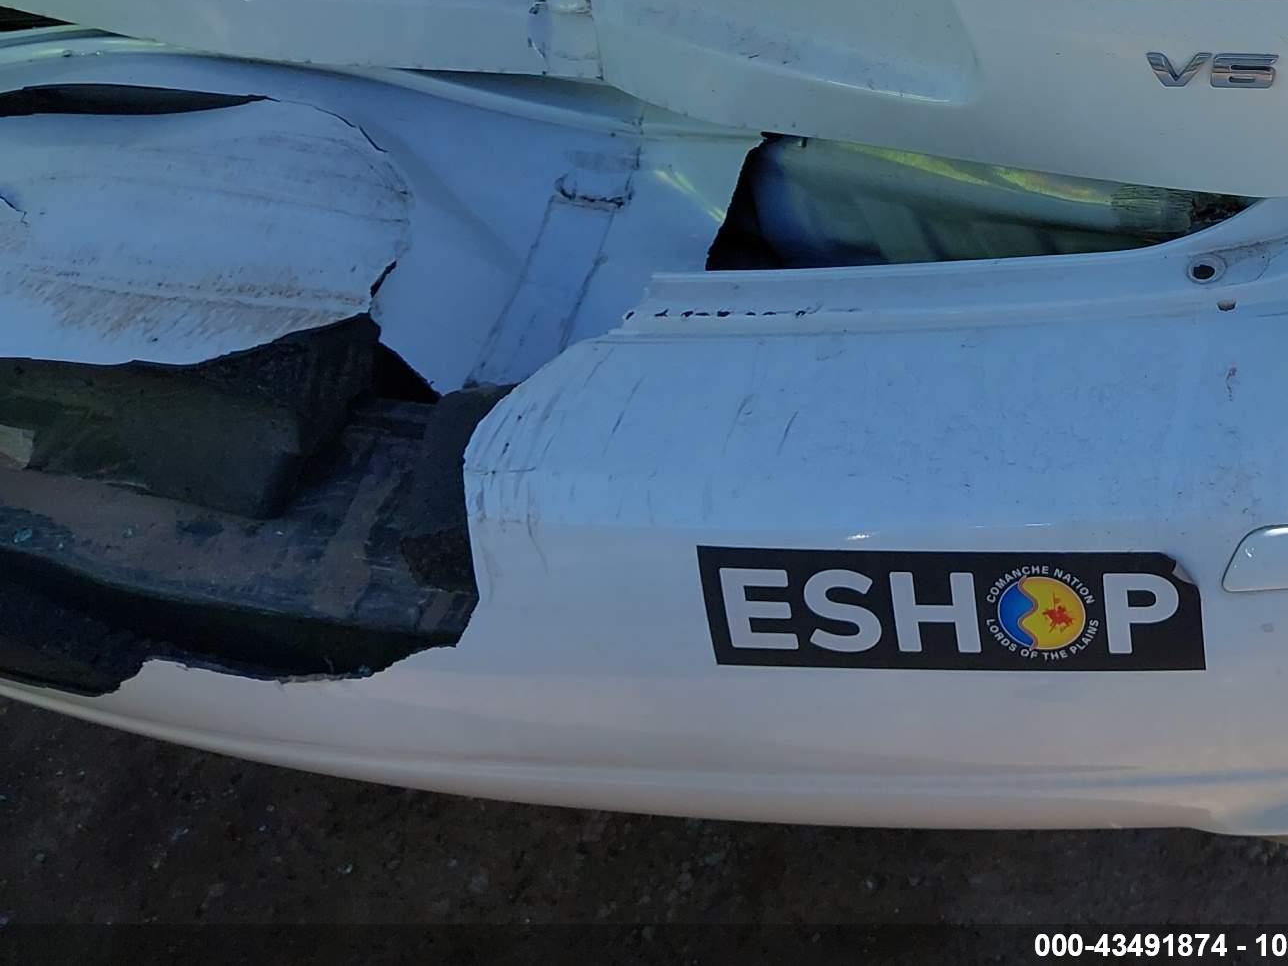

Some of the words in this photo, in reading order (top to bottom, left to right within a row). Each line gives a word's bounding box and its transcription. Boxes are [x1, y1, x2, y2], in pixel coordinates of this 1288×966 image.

[1145, 52, 1279, 88] V6
[986, 565, 1050, 604] COMANCHE
[1053, 568, 1096, 604] NATION
[986, 618, 1018, 653] LORDS
[1020, 648, 1038, 660] OF
[1042, 649, 1069, 661] THE
[1069, 618, 1100, 655] PLAINS
